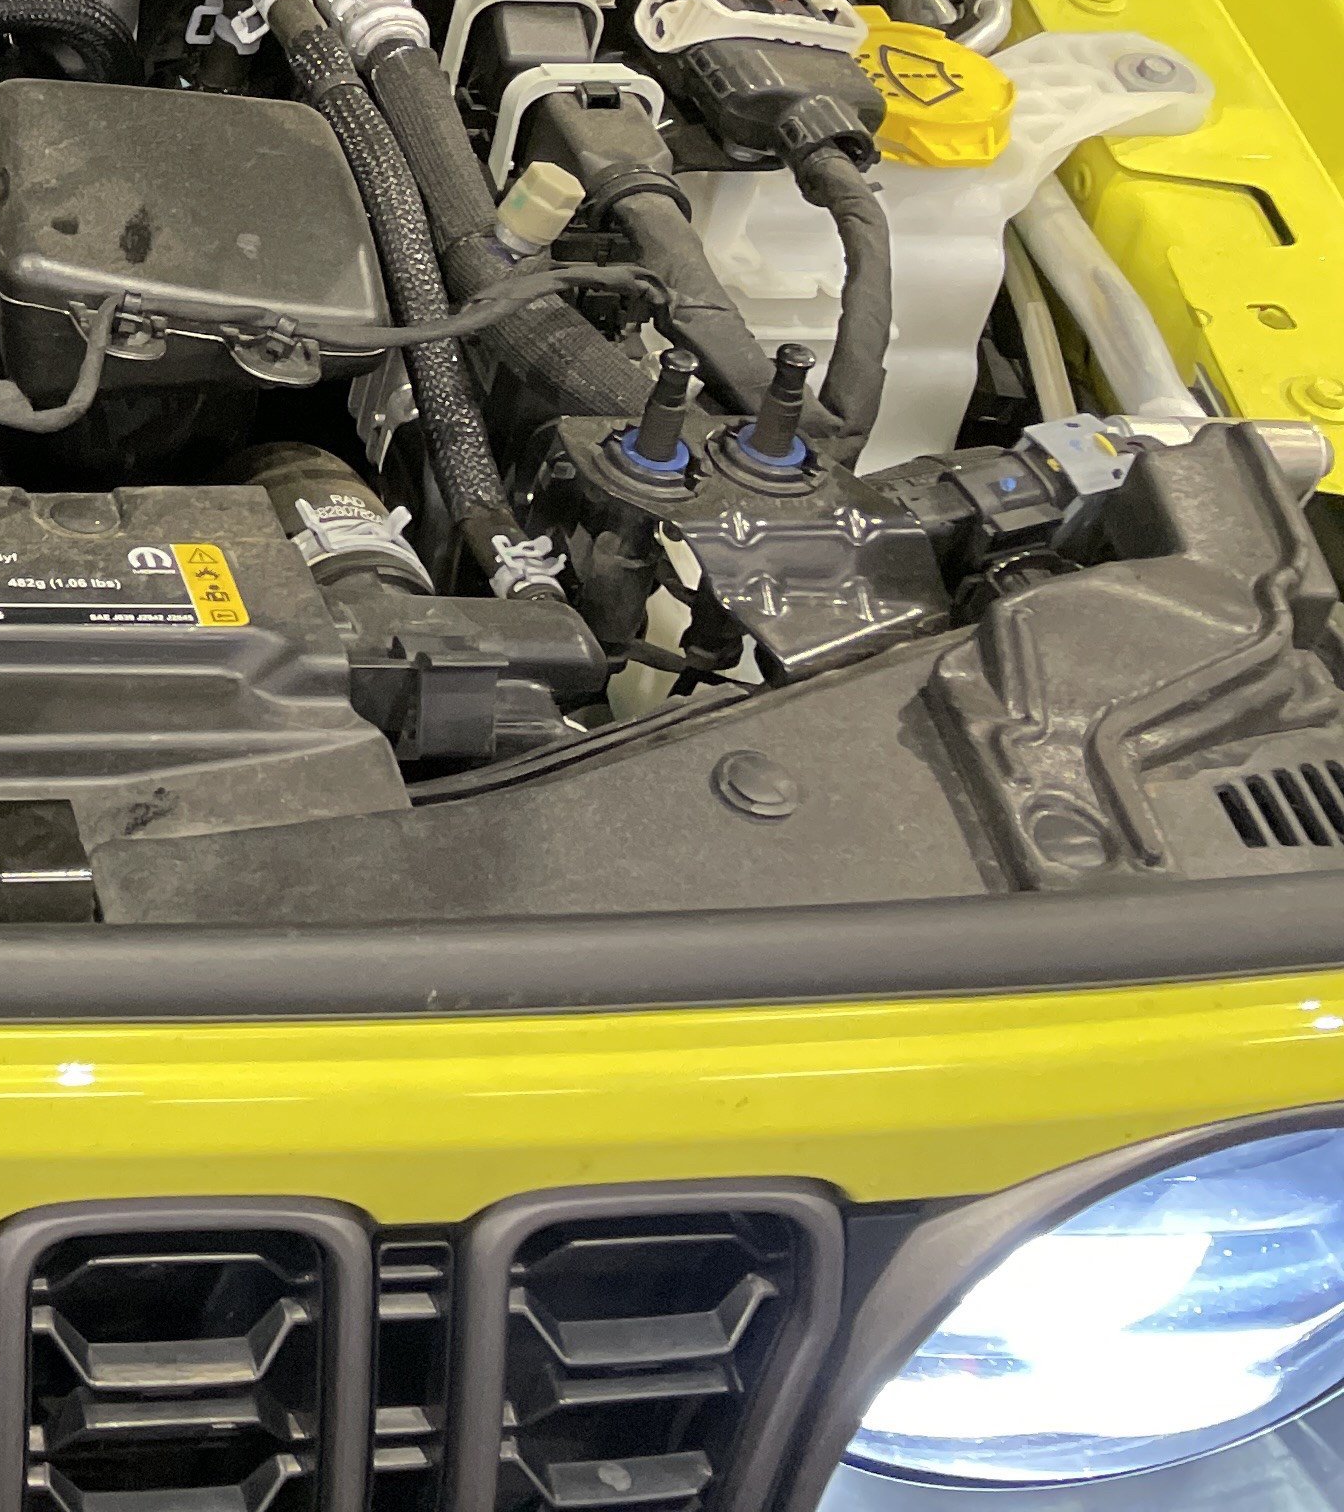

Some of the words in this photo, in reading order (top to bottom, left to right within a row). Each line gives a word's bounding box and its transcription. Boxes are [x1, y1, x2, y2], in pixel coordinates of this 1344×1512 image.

[329, 494, 366, 508] RAD
[7, 578, 45, 590] 482g
[50, 578, 88, 590] (1.06
[91, 578, 121, 590] lbs)
